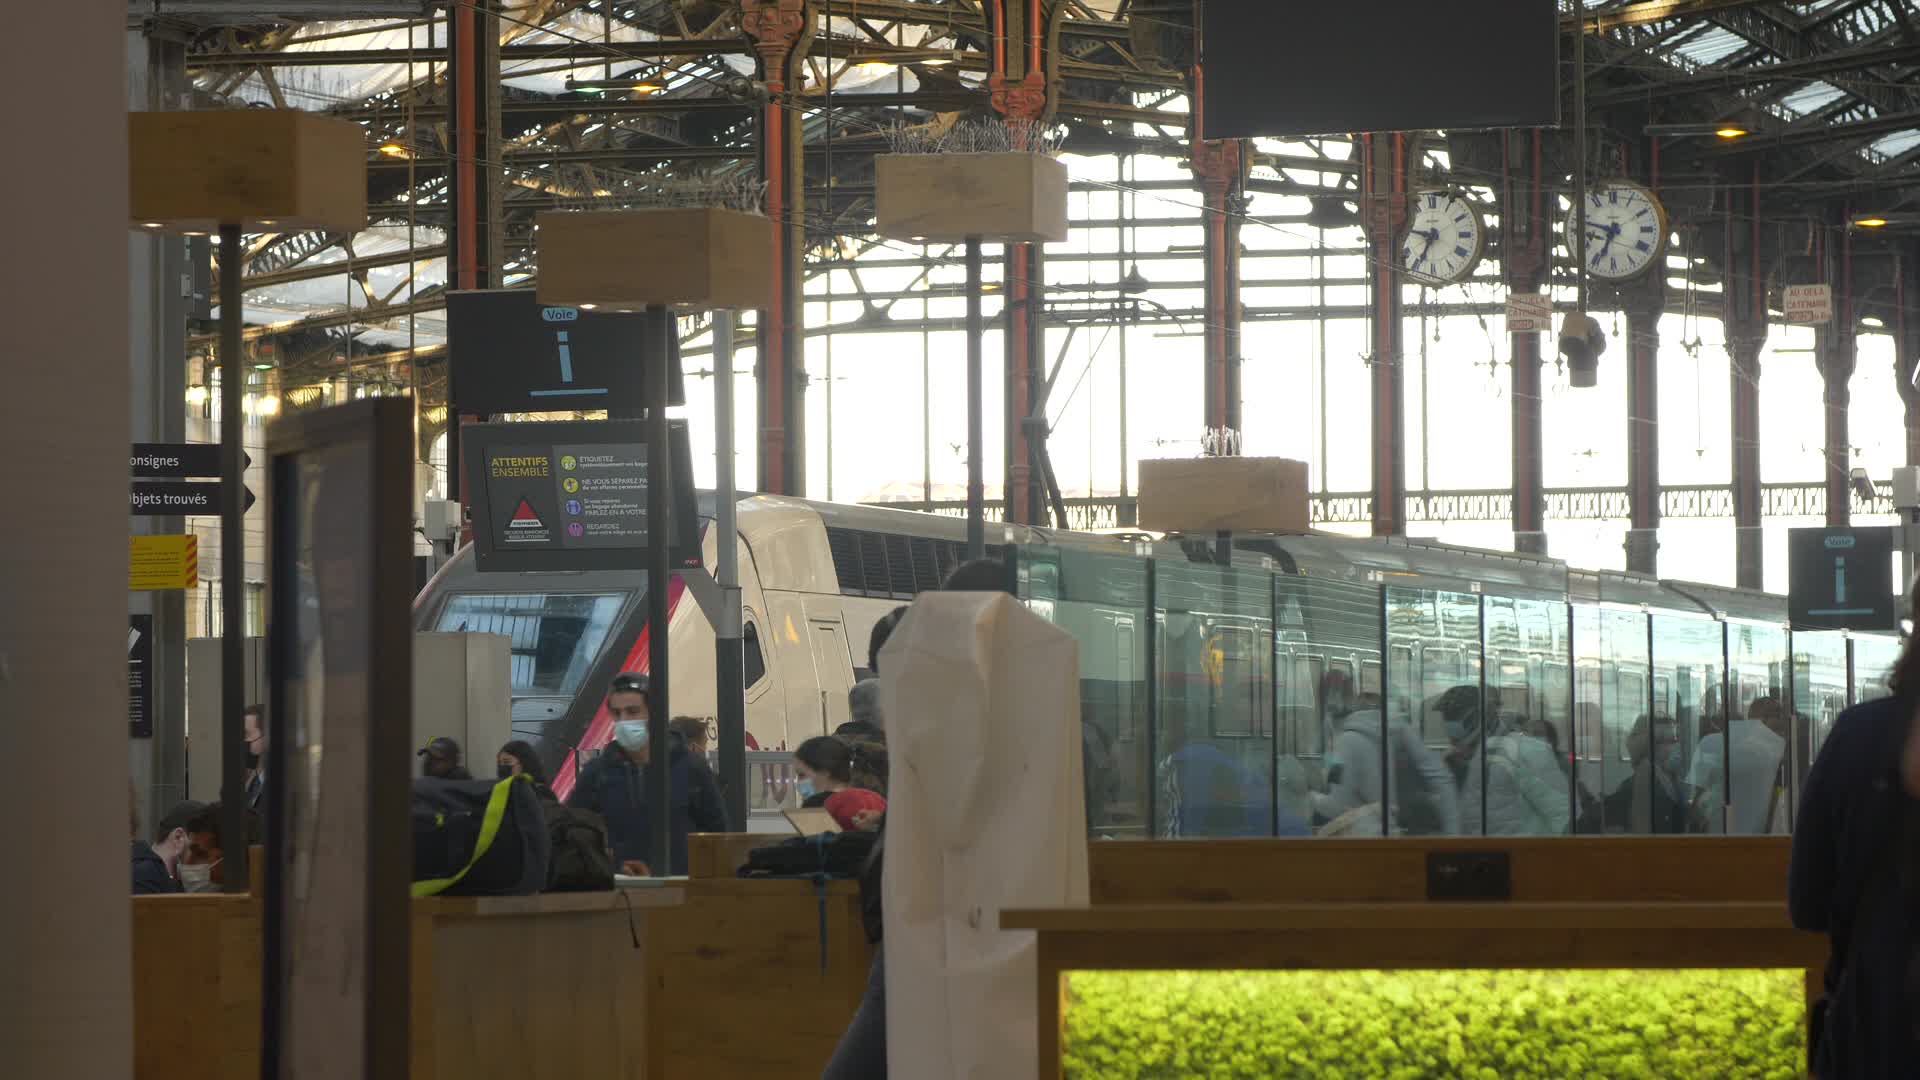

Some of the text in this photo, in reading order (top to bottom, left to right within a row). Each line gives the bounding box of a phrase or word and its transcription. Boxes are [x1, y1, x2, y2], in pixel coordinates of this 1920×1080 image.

[547, 309, 573, 320] Voie
[129, 454, 179, 469] onsignes
[492, 456, 549, 467] ATTENTIFS
[492, 466, 549, 477] ENSEMBLE
[129, 492, 207, 508] bjets trouvés
